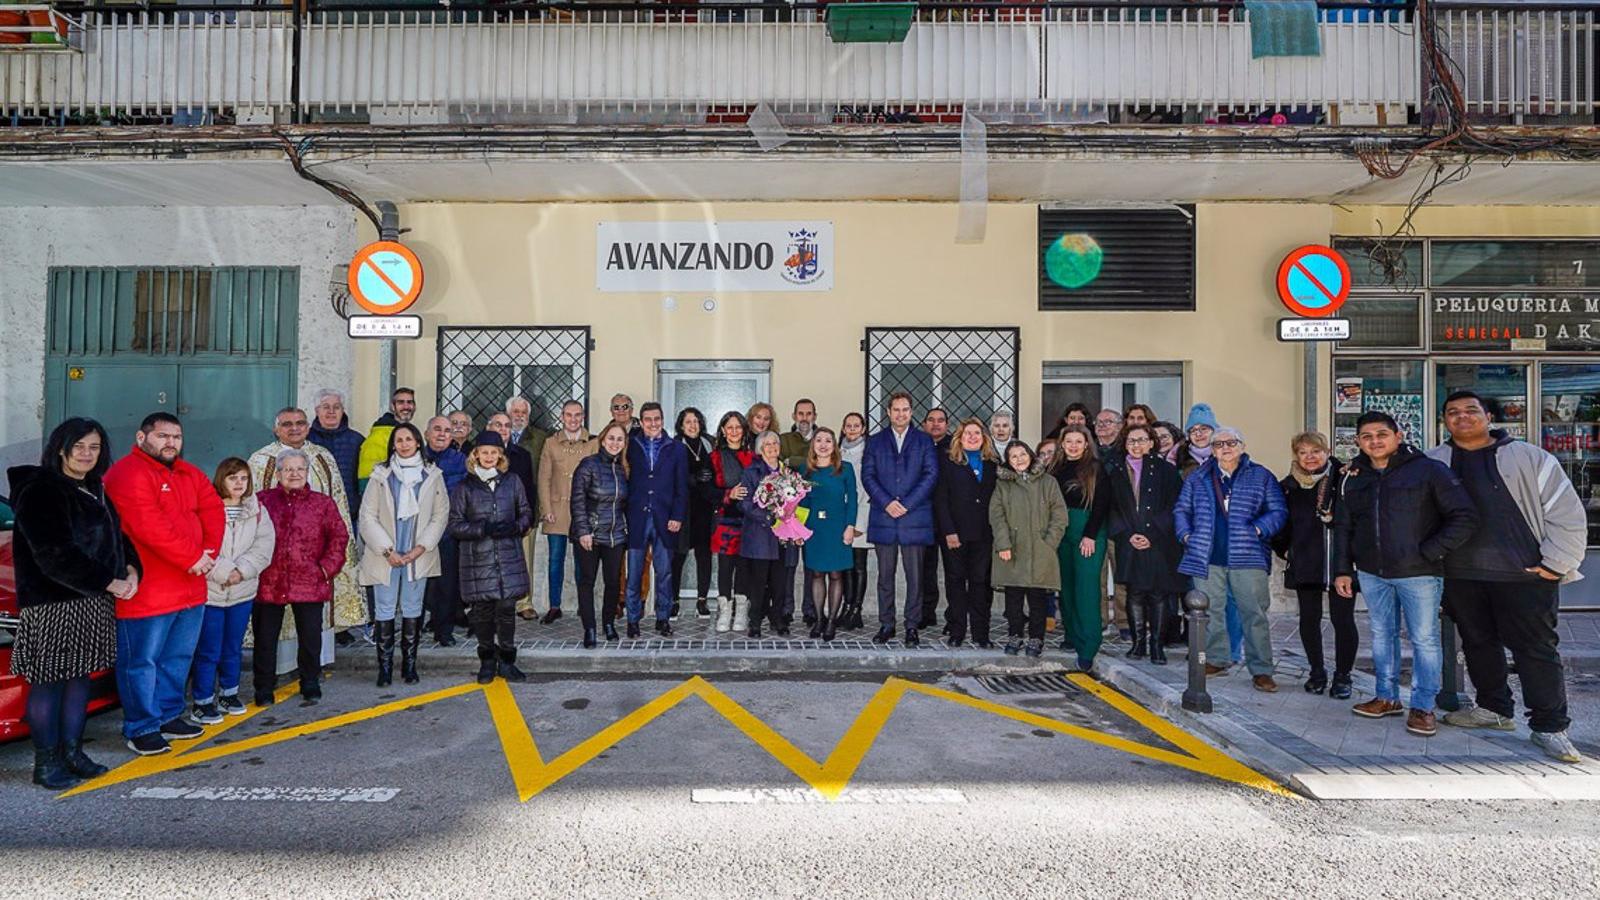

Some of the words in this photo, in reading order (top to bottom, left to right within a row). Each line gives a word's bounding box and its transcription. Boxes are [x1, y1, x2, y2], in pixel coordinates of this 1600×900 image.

[606, 242, 774, 270] AVANZANDO
[1572, 260, 1583, 274] 7
[1435, 298, 1571, 312] PELUQUERIA
[1445, 327, 1521, 339] SENEGAL
[158, 391, 166, 404] 3
